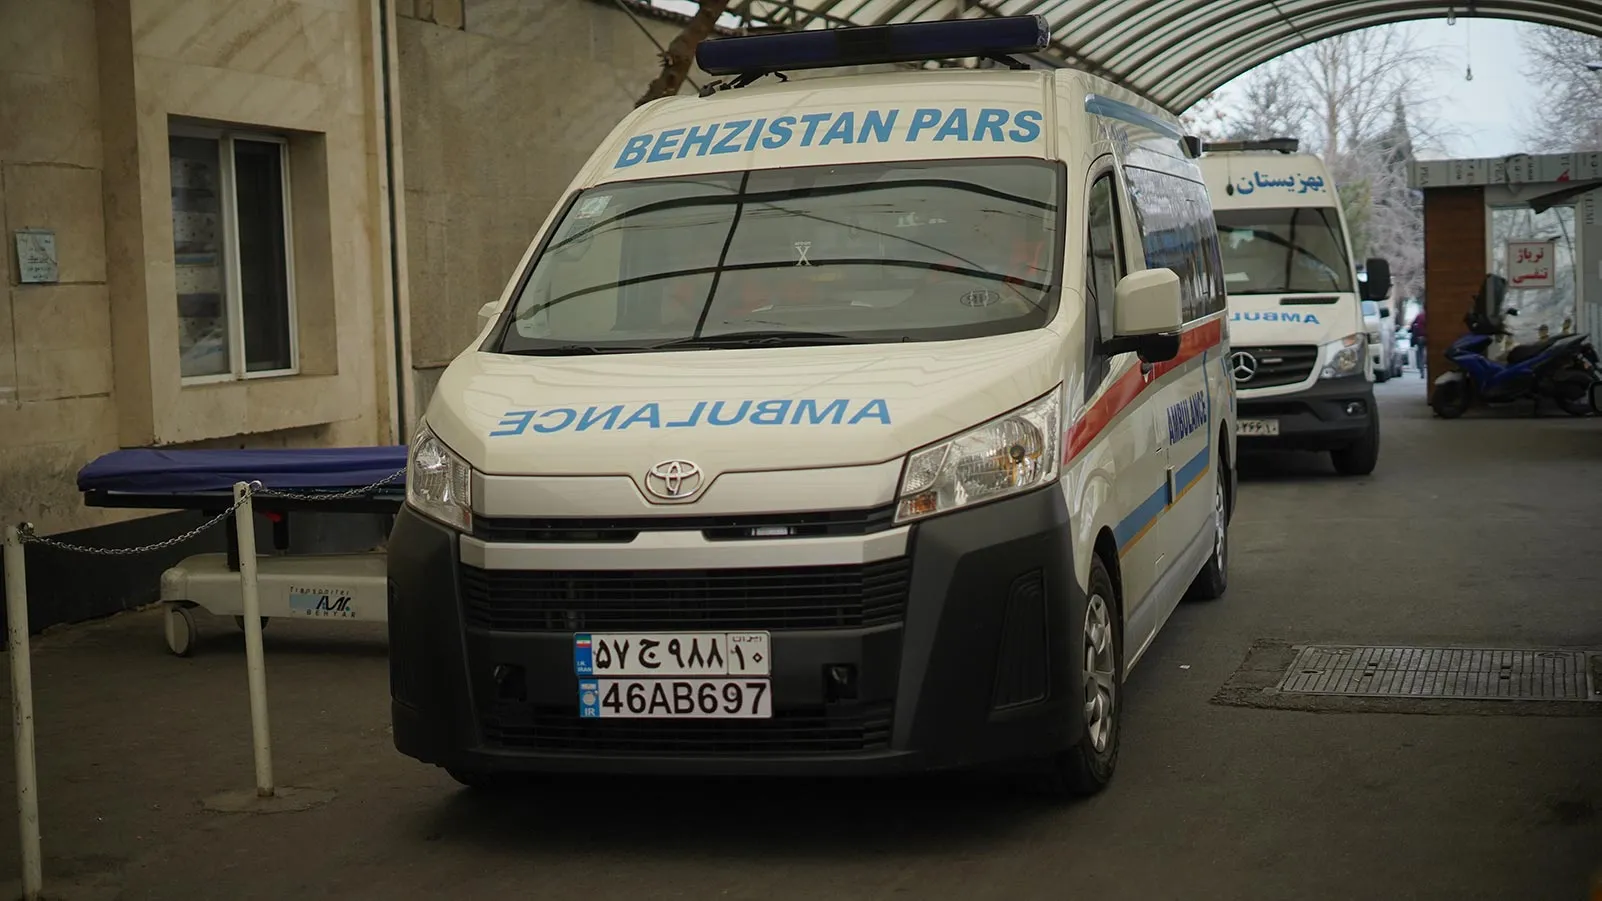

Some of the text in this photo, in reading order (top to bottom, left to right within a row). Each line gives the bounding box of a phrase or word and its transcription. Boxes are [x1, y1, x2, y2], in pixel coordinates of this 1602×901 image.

[613, 108, 1043, 169] BEHZISTAN PARS
[1236, 171, 1327, 195] بهزیستان
[1511, 267, 1549, 284] تنفسی
[1167, 390, 1207, 446] AMBULANCE
[584, 707, 596, 717] IR
[602, 682, 767, 715] 46AB697
